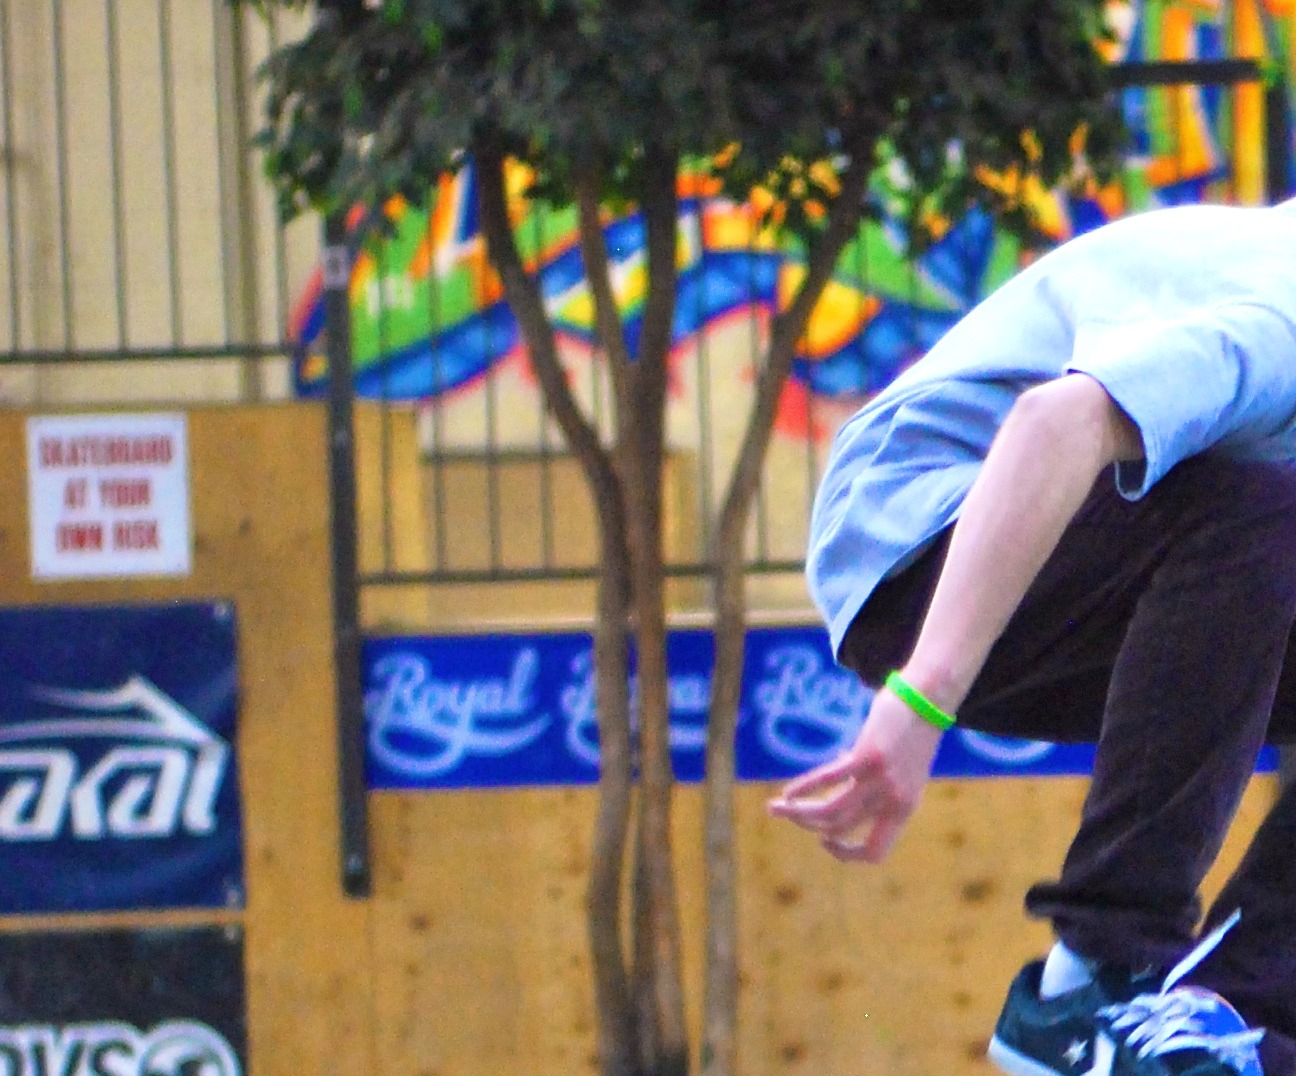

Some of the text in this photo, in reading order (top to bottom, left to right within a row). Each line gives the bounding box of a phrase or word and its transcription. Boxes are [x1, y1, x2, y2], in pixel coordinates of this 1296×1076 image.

[39, 434, 174, 468] SKATEBOARD
[64, 477, 151, 510] AT YOUR
[56, 518, 160, 553] OWN RISK
[364, 648, 548, 774] Royal
